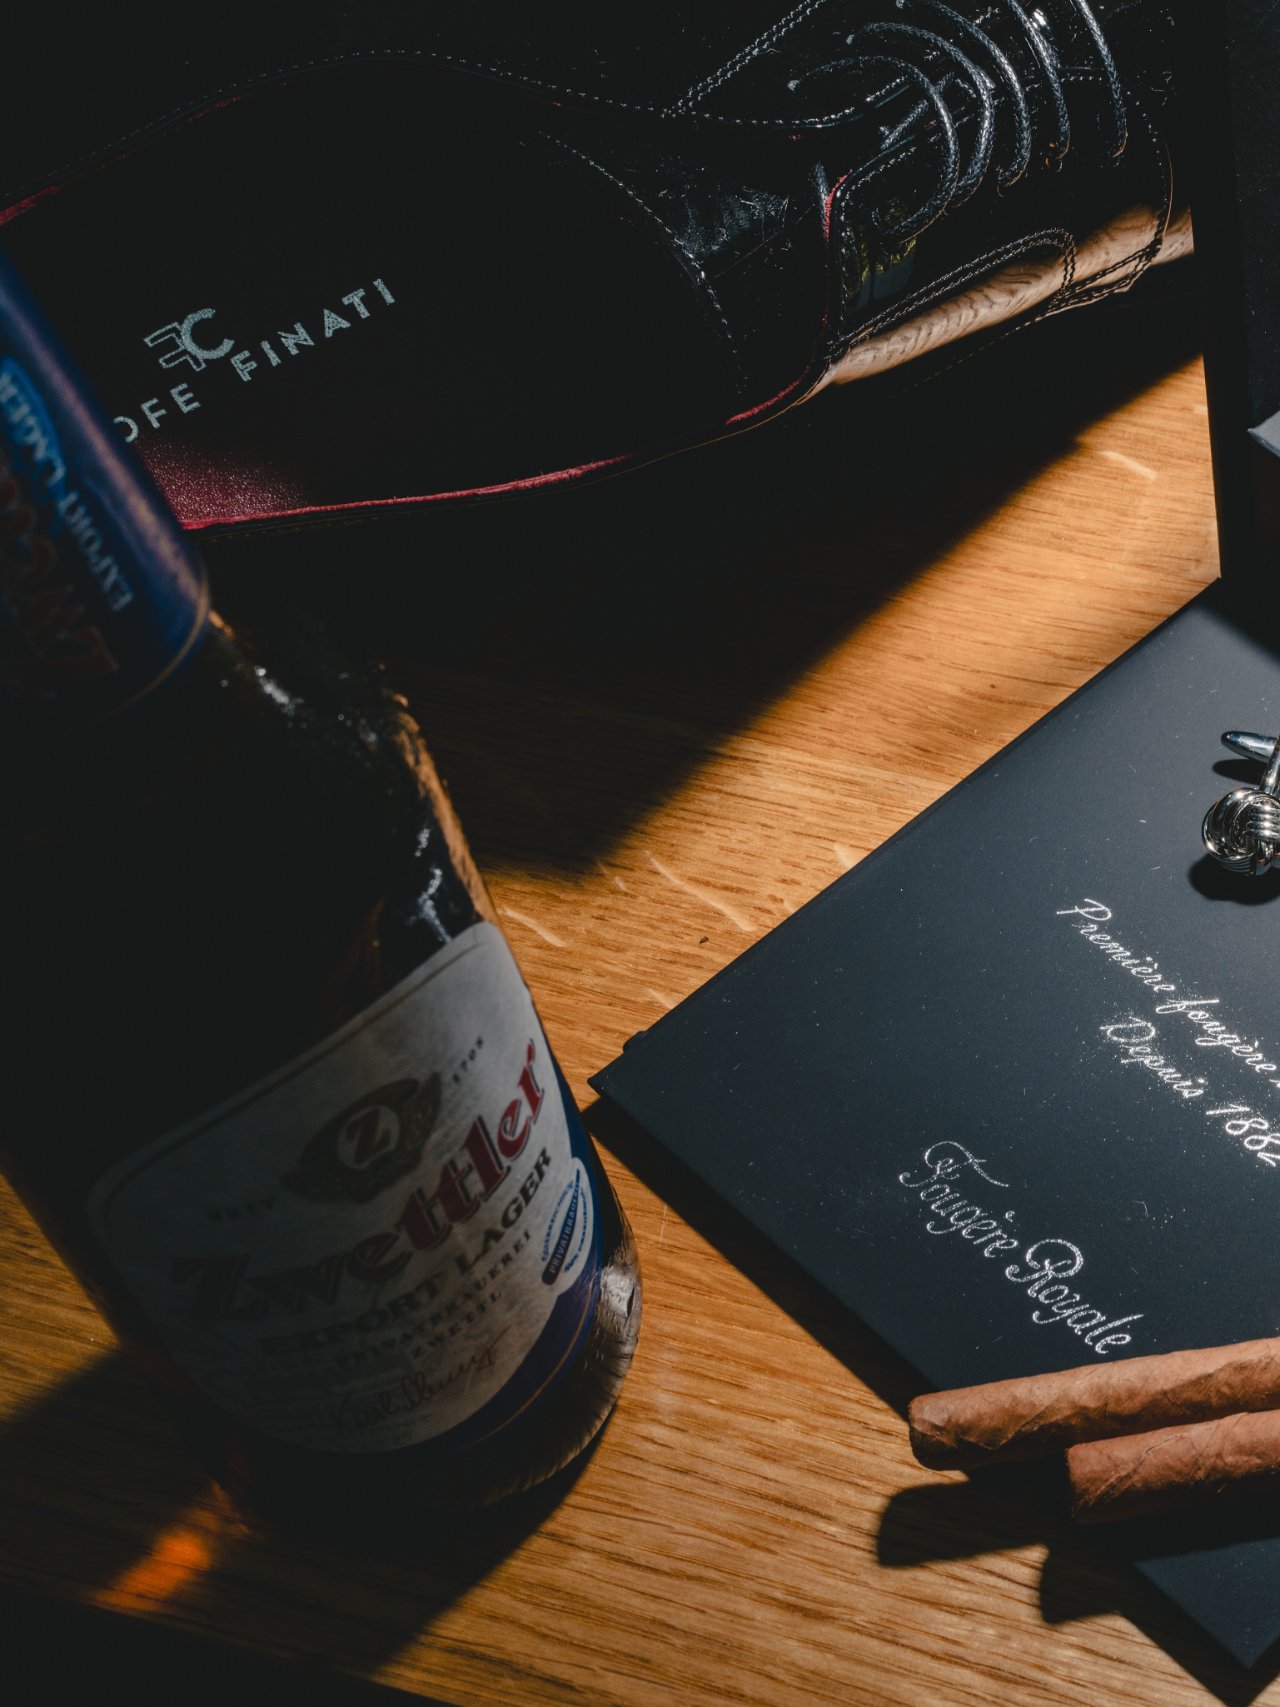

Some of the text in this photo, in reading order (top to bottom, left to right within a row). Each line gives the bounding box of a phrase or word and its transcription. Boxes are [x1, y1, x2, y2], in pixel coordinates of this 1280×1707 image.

[230, 279, 396, 382] FINATI
[1056, 898, 1175, 994] Première
[1155, 998, 1278, 1074] fougère
[1101, 1016, 1205, 1100] Depuis
[169, 1038, 544, 1322] Zwettler
[256, 1269, 449, 1354] EXPORT
[453, 1147, 551, 1275] LAGER
[899, 1140, 1145, 1355] Fougère Royale
[411, 1291, 503, 1360] ZWETTL
